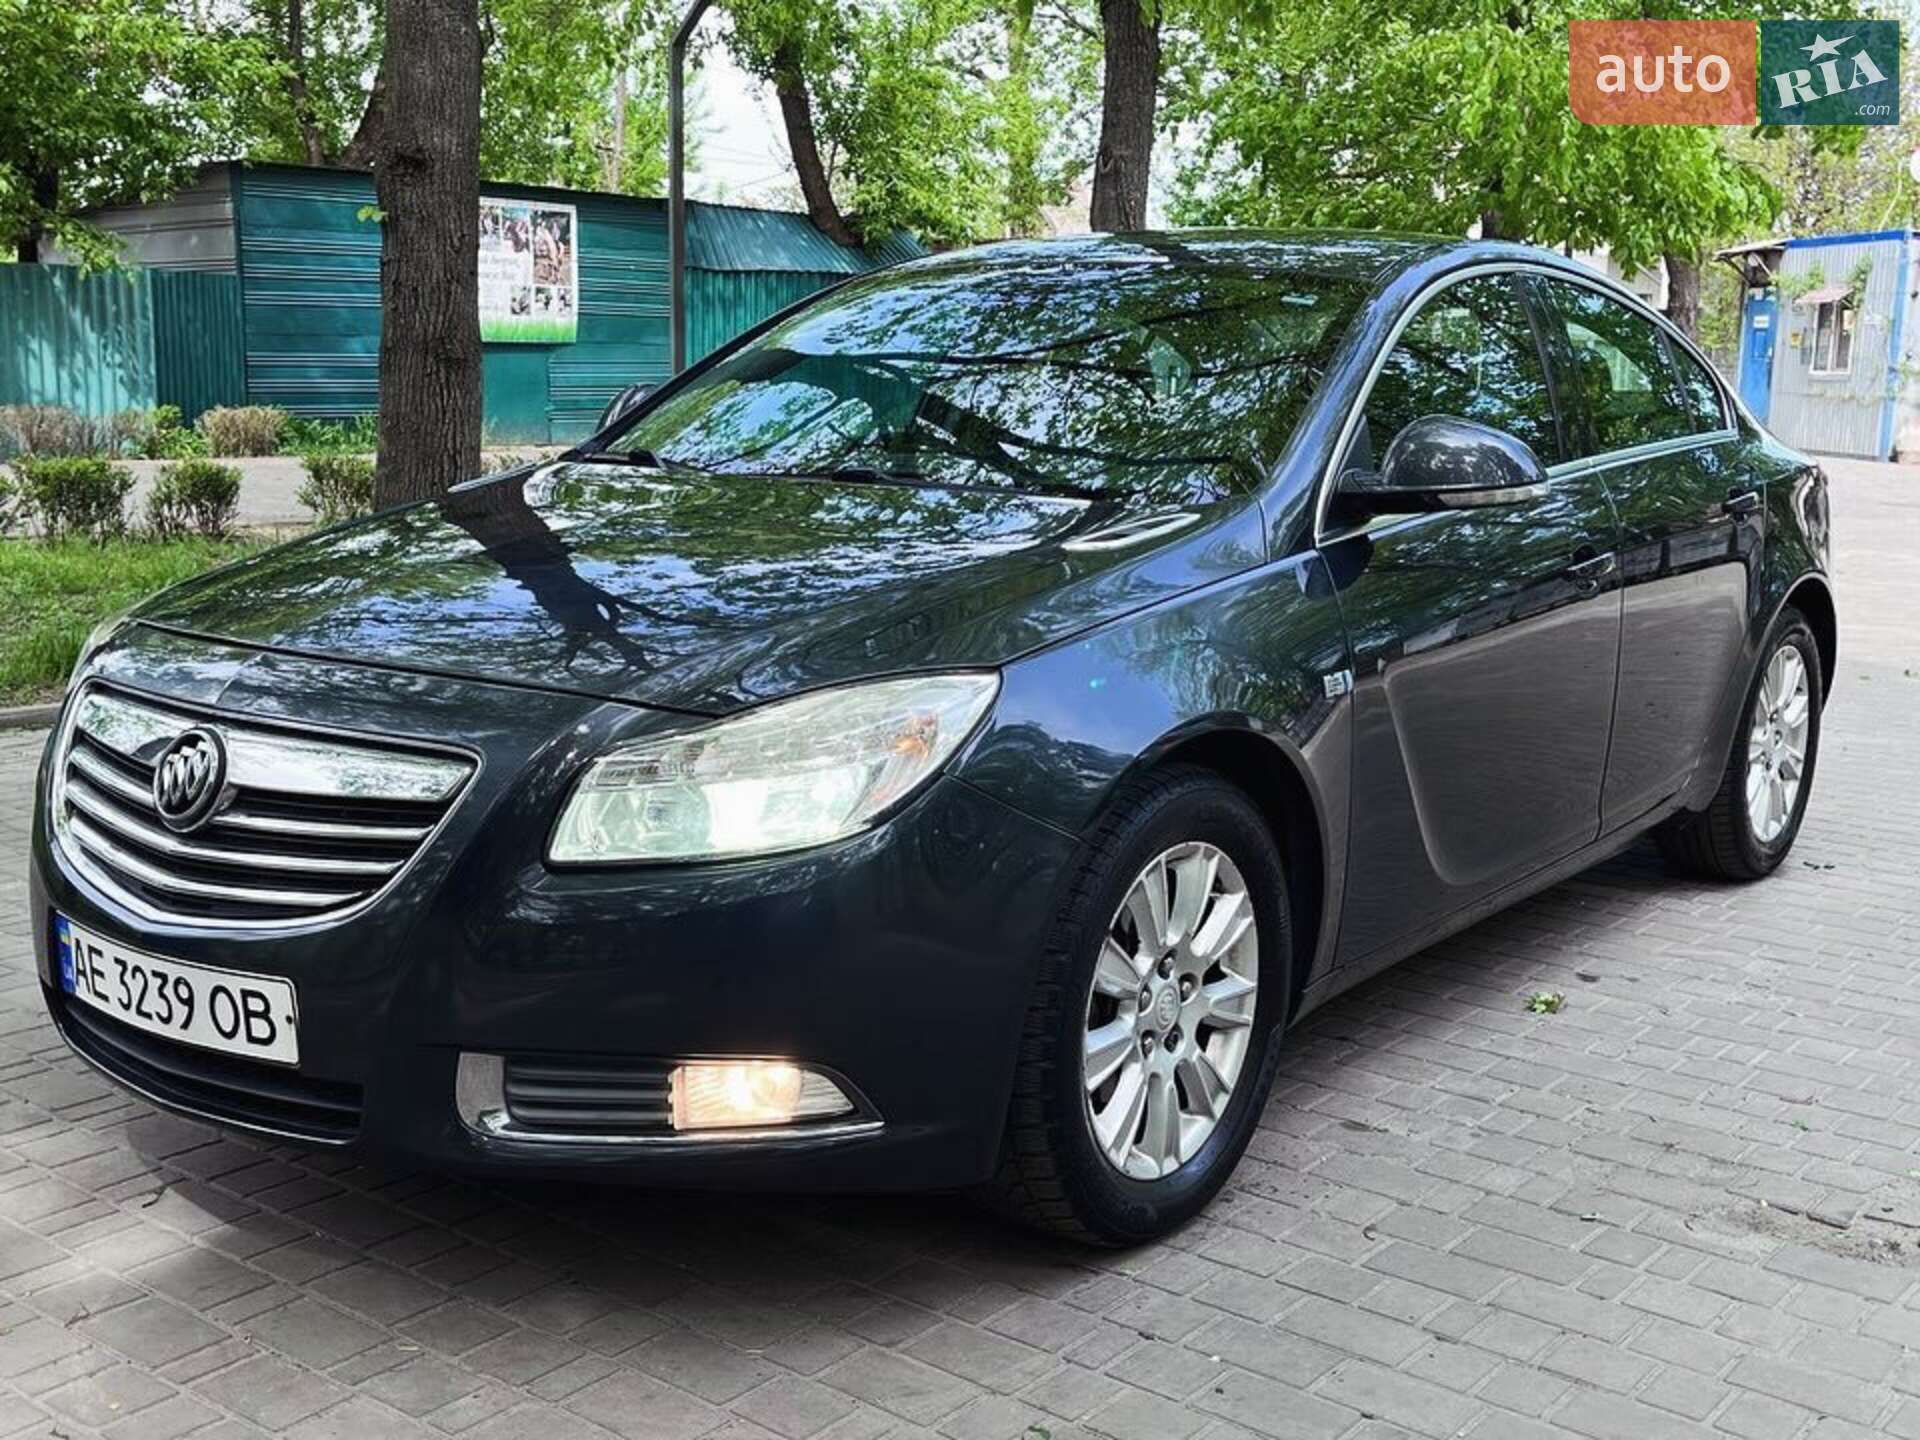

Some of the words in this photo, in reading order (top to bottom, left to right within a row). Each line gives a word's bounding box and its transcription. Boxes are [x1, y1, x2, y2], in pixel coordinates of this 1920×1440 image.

[74, 938, 110, 1003] AE
[114, 957, 195, 1031] 3239
[209, 984, 277, 1046] OB
